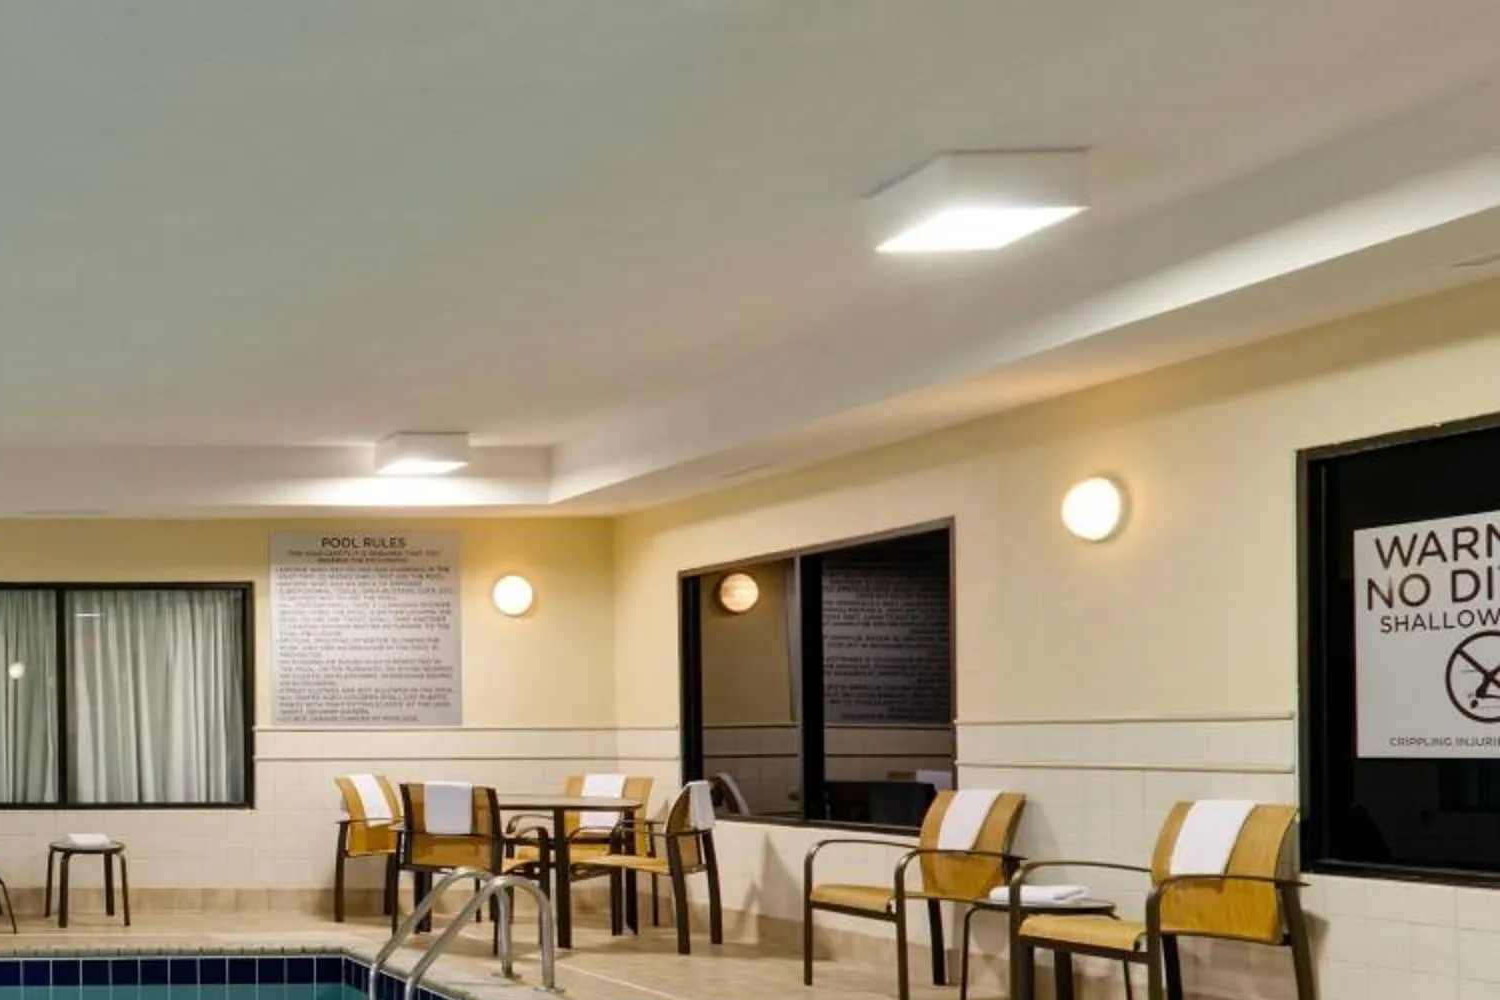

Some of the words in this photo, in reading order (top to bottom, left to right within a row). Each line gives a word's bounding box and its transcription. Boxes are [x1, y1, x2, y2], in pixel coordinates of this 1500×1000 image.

[321, 537, 360, 549] POOL
[363, 537, 407, 549] RULES
[1367, 573, 1431, 611] NO
[1451, 566, 1500, 604] DI
[1380, 608, 1500, 633] SHALLOW
[1389, 736, 1453, 748] CRIPPLING
